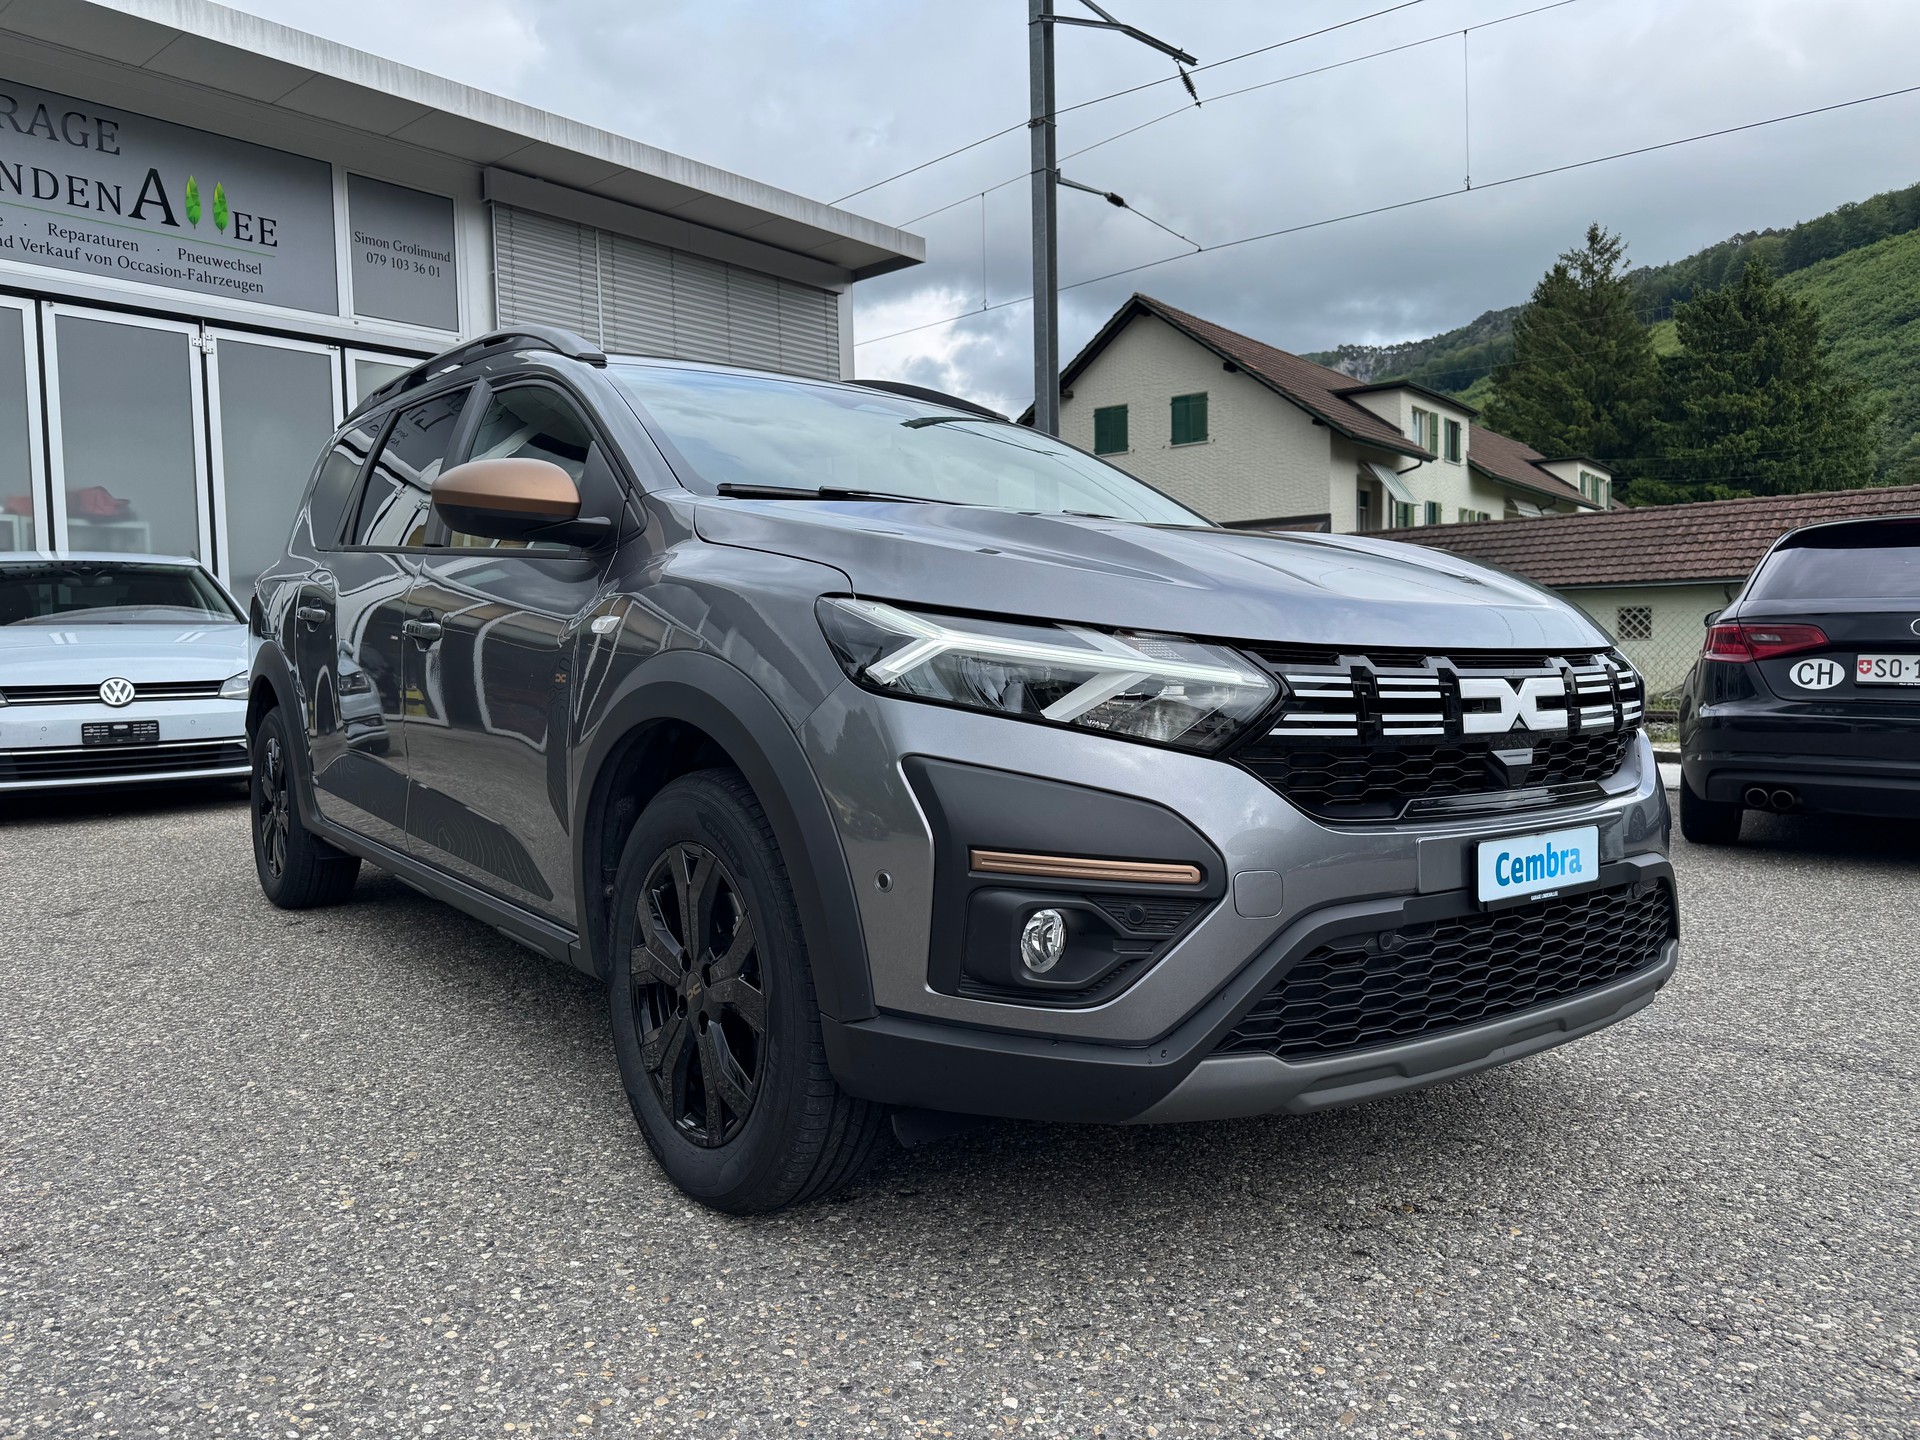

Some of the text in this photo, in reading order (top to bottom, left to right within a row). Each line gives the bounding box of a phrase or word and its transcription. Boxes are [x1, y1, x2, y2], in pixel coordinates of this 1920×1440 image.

[0, 94, 120, 156] RAGE
[19, 237, 81, 260] Verkauf
[84, 252, 112, 266] von
[117, 255, 264, 294] Occasion-Fahrzeugen
[47, 222, 262, 275] Reparaturen Pneuwechsel
[354, 231, 451, 262] Simon Grolimund
[366, 252, 440, 277] 079 103 36 01
[1797, 662, 1834, 686] CH
[1495, 842, 1583, 887] Cembra
